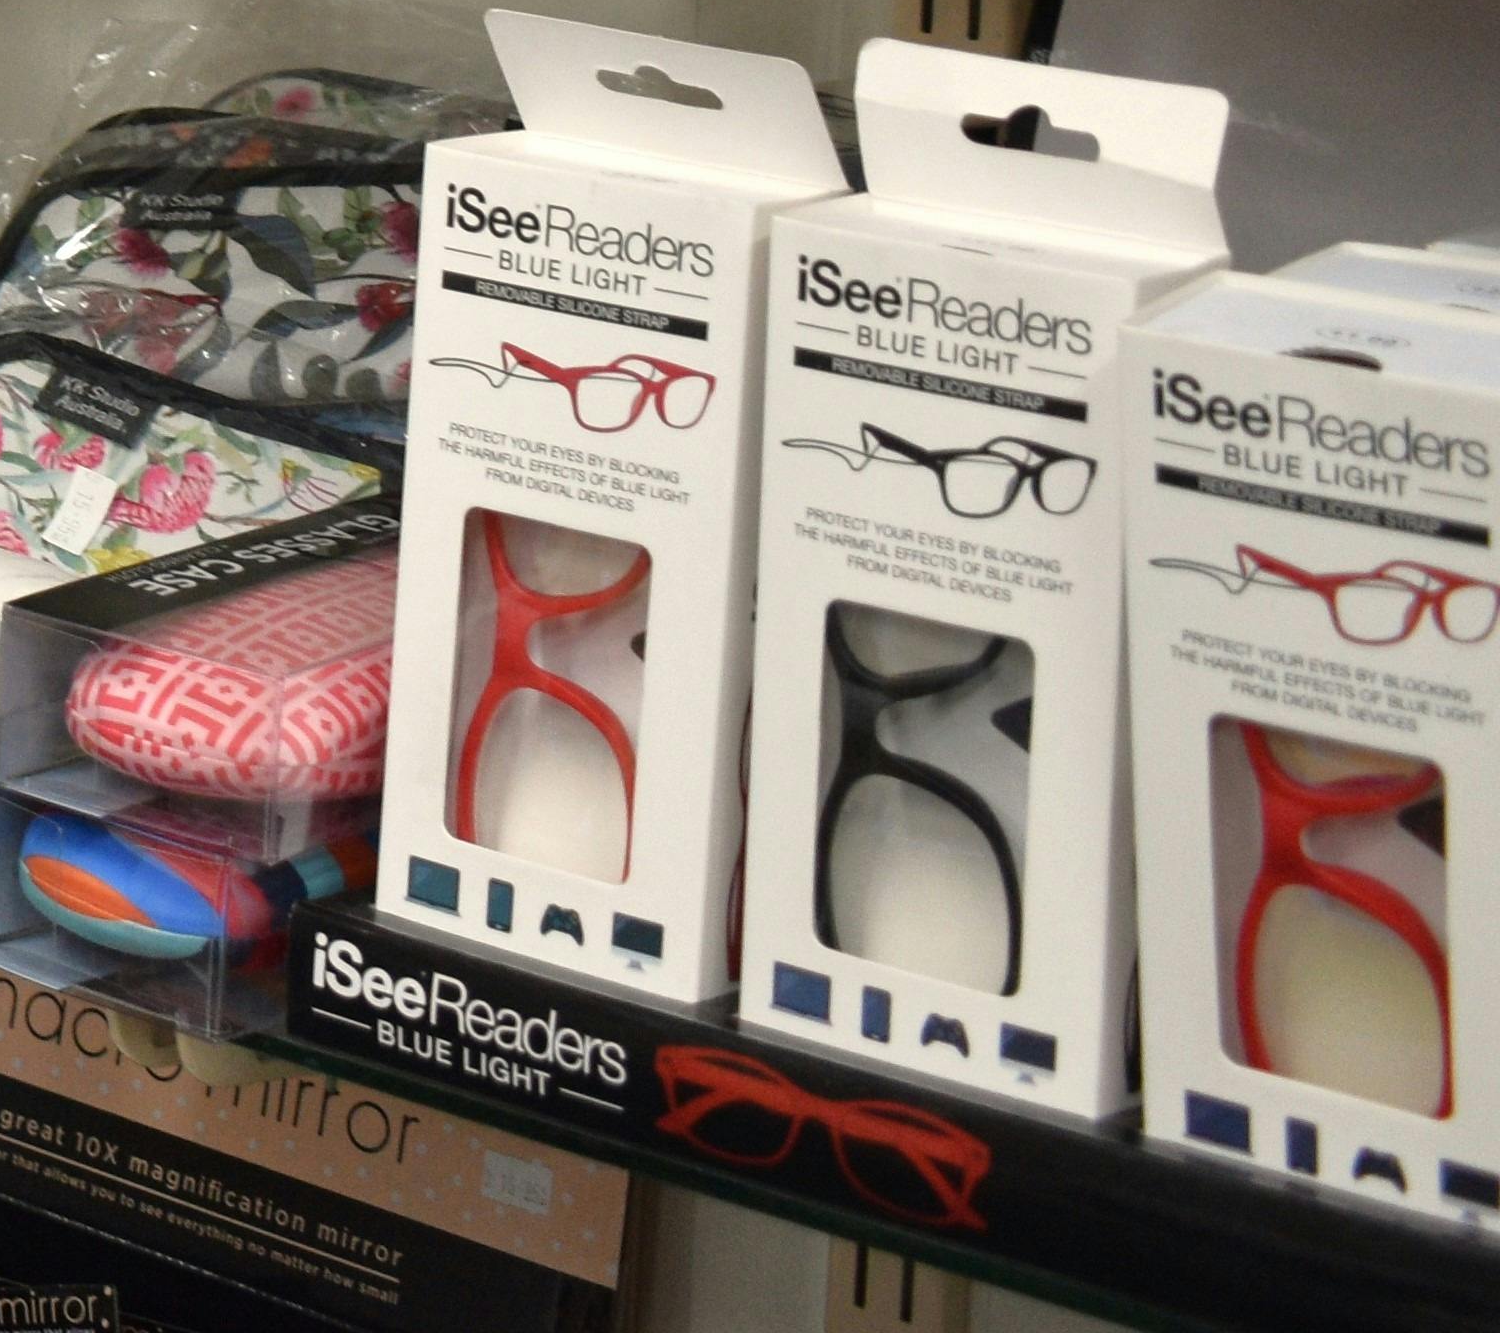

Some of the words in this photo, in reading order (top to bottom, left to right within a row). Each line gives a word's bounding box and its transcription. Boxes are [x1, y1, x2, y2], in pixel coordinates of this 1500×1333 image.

[140, 209, 213, 222] Australia
[168, 193, 224, 208] Studio
[498, 250, 561, 281] BLUE
[572, 265, 647, 296] LIGHT
[475, 280, 554, 310] REMOVABLE
[557, 296, 620, 321] SILICONE
[622, 309, 670, 330] STRAP
[857, 324, 925, 358] BLUE
[937, 340, 1020, 375] LIGHT
[88, 386, 140, 417] Studio
[832, 357, 920, 387] REMOVABLE
[923, 374, 991, 403] SILICONE
[993, 389, 1045, 411] STRAP
[439, 437, 462, 456] THE
[465, 442, 525, 469] HARMFUL
[529, 458, 586, 482] EFFECTS
[589, 469, 608, 486] OF
[611, 474, 647, 496] BLUE
[650, 483, 690, 505] LIGHT
[449, 422, 507, 446] PROTECT
[510, 434, 548, 456] YOUR
[550, 443, 585, 465] EYES
[588, 452, 606, 470] BY
[609, 458, 680, 485] BLOCKING
[1223, 442, 1301, 479] BLUE
[1315, 459, 1410, 497] LIGHT
[485, 468, 523, 491] FROM
[526, 476, 574, 499] DIGITAL
[578, 488, 635, 513] DEVICES
[242, 511, 401, 565] GLASSES
[794, 523, 820, 542] THE
[823, 529, 891, 557] HARMFUL
[895, 545, 958, 571] EFFECTS
[962, 558, 982, 575] OF
[985, 563, 1024, 586] BLUE
[1028, 574, 1074, 596] LIGHT
[805, 507, 870, 533] PROTECT
[874, 520, 914, 543] YOUR
[917, 531, 954, 552] EYES
[959, 540, 979, 557] BY
[983, 546, 1061, 574] BLOCKING
[127, 555, 244, 597] CASE
[846, 555, 889, 578] FROM
[891, 565, 945, 589] DIGITAL
[949, 578, 1012, 603] DEVICES
[1181, 630, 1253, 658] PROTECT
[1258, 647, 1304, 669] YOUR
[1308, 658, 1350, 680] EYES
[1355, 667, 1378, 685] BY
[1381, 672, 1472, 704] BLOCKING
[376, 1018, 453, 1067] BLUE
[462, 1046, 551, 1096] LIGHT
[0, 1108, 64, 1146] great
[76, 1132, 119, 1166] 10X
[128, 1153, 306, 1233] magnification
[317, 1220, 403, 1266] mirror
[11, 1153, 39, 1173] that
[43, 1166, 87, 1191] allows
[90, 1185, 116, 1202] you
[120, 1193, 135, 1207] to
[139, 1201, 165, 1215] see
[167, 1211, 244, 1251] everything
[248, 1241, 266, 1256] no
[270, 1250, 319, 1277] matter
[323, 1266, 353, 1289] how
[359, 1281, 398, 1305] small
